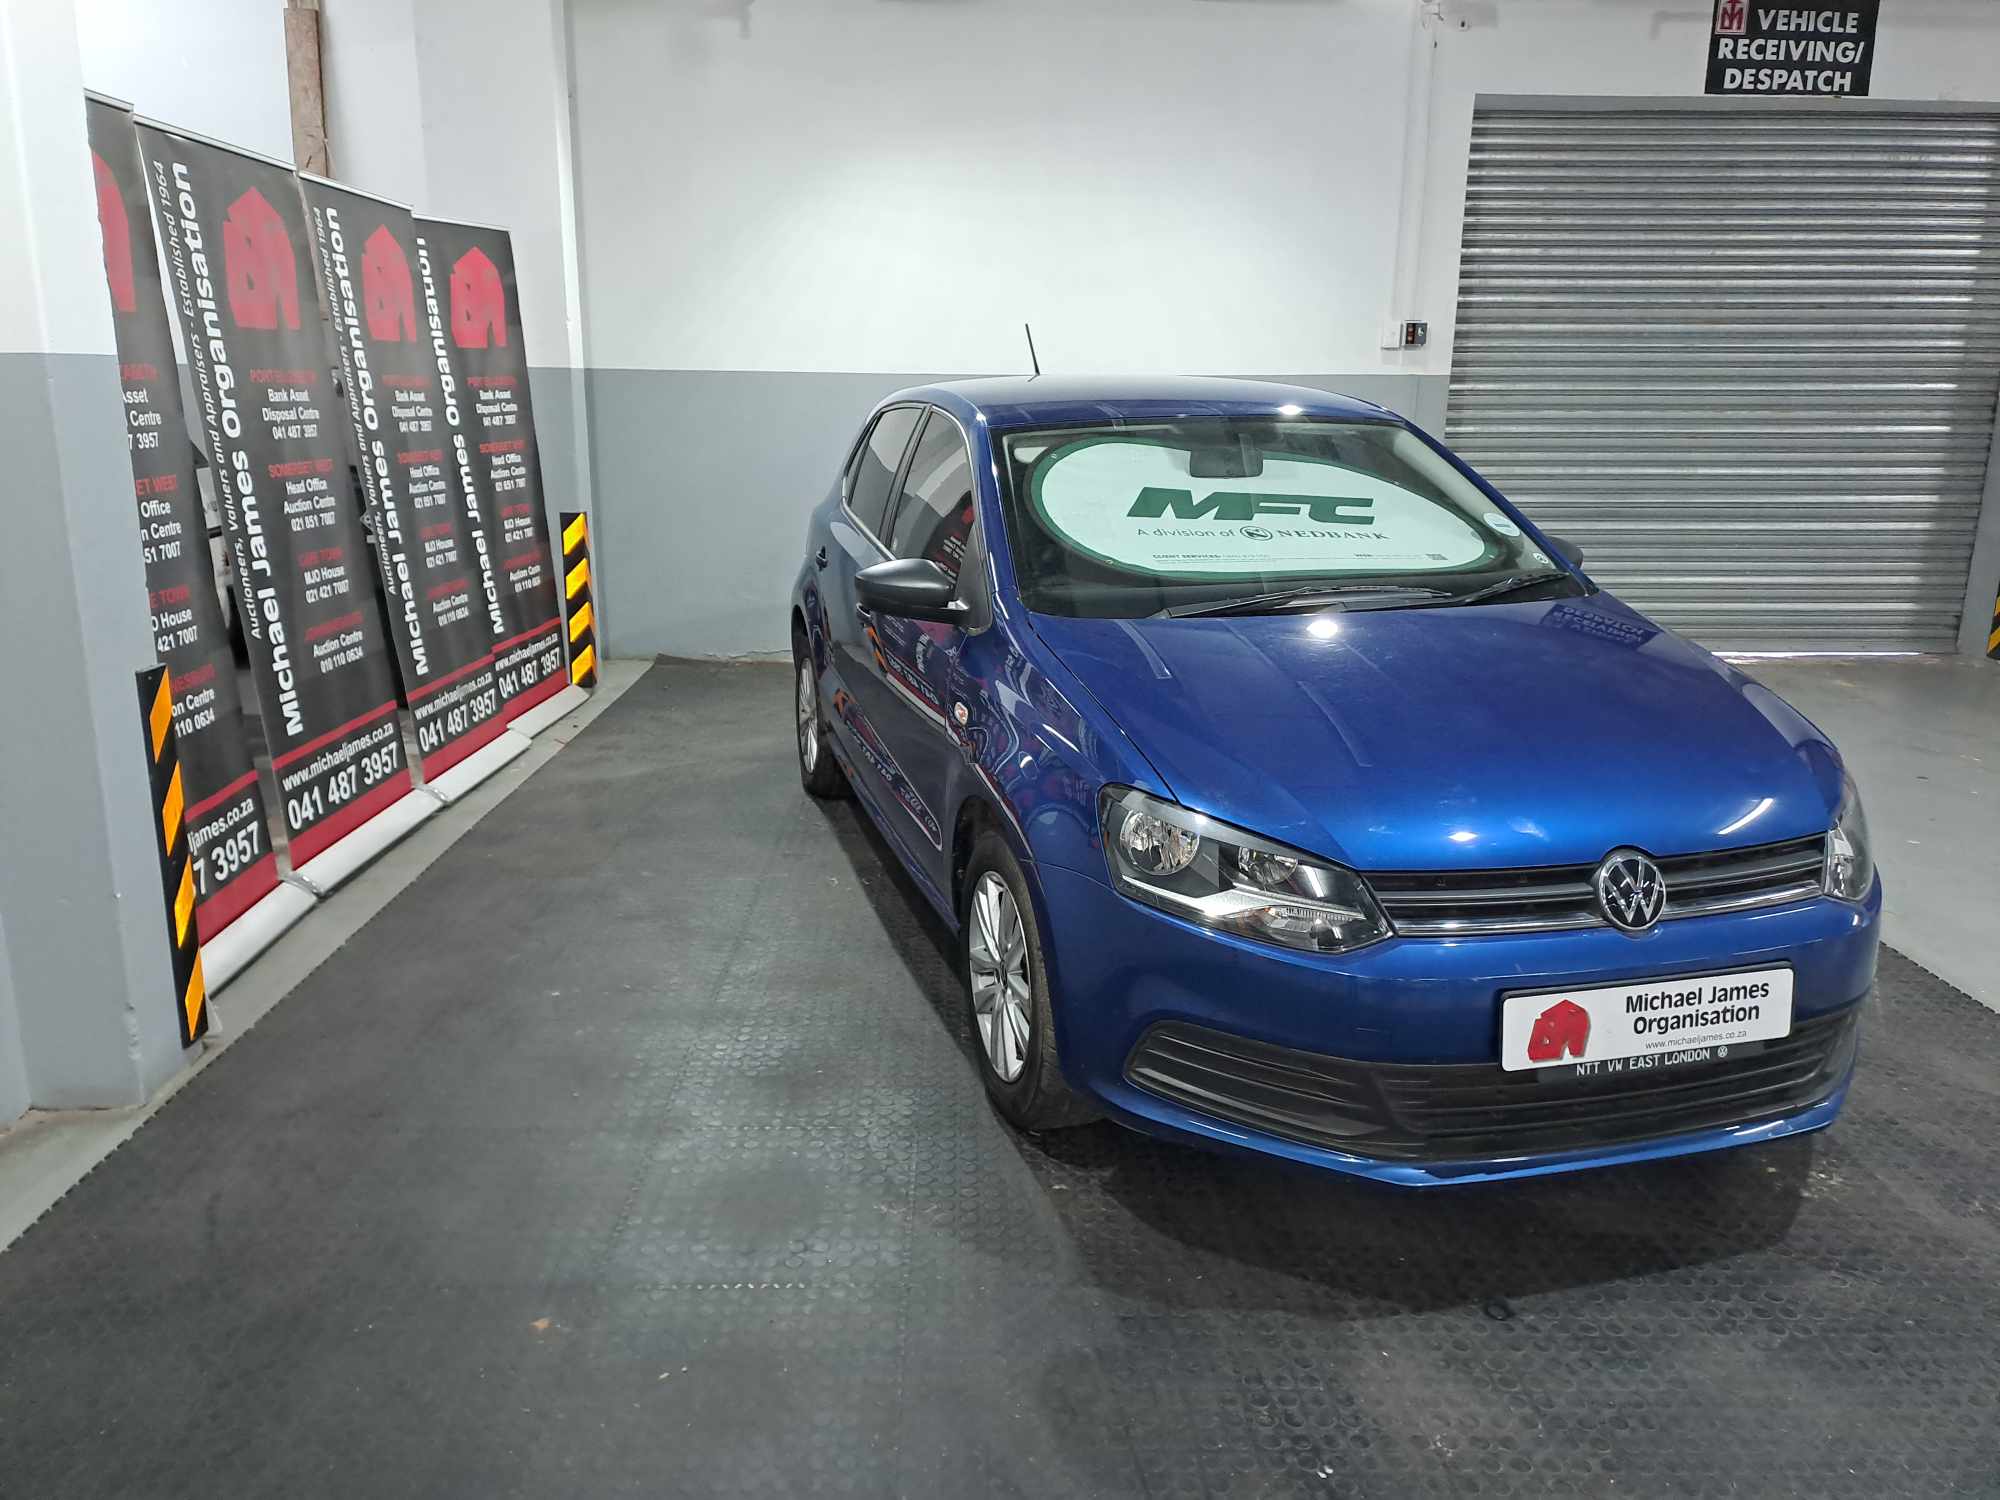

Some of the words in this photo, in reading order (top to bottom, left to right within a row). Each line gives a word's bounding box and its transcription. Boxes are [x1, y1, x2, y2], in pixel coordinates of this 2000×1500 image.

[1757, 9, 1860, 34] VEHICLE
[1717, 38, 1865, 64] RECEIVING/
[1723, 68, 1852, 92] DESPATCH
[153, 160, 172, 206] 1964
[163, 211, 195, 317] Established
[172, 162, 241, 439] Organisation
[326, 207, 378, 431] Organisation
[191, 332, 217, 426] Appraisers
[340, 345, 361, 419] Appraisers
[129, 410, 162, 426] Centre
[262, 407, 297, 424] Disposal
[136, 432, 159, 449] 3957
[208, 429, 225, 464] and
[353, 422, 367, 451] and
[362, 454, 378, 506] Valuers
[371, 440, 402, 544] James
[453, 433, 480, 523] James
[140, 500, 171, 518] Office
[219, 468, 238, 531] Valuers
[232, 450, 272, 576] James
[284, 499, 313, 515] Auction
[1126, 487, 1375, 525] MFC
[150, 521, 182, 539] Centre
[1137, 528, 1150, 536] A
[1153, 528, 1216, 537] division
[1218, 528, 1236, 537] of
[1276, 529, 1392, 540] NEDBANK
[159, 541, 181, 560] 7007
[234, 537, 261, 639] Auctioneers,
[471, 530, 504, 634] Michael
[160, 608, 192, 629] House
[392, 553, 429, 676] Michael
[157, 632, 175, 652] 421
[177, 625, 198, 646] 7007
[313, 639, 340, 658] Auction
[257, 587, 304, 736] Michael
[499, 670, 519, 699] 041
[520, 660, 538, 687] 487
[541, 647, 560, 676] 3957
[186, 688, 215, 710] Centre
[175, 718, 193, 738] 110
[194, 707, 216, 730] 0634
[419, 718, 445, 752] 041
[447, 705, 468, 736] 487
[470, 688, 497, 722] 3957
[282, 722, 394, 792] www.michaeljames.co.za
[287, 785, 324, 830] 041
[328, 764, 357, 804] 487
[361, 741, 398, 785] 3957
[211, 821, 259, 881] 3957
[1625, 987, 1703, 1013] Michael
[1708, 982, 1770, 1004] James
[1633, 1004, 1760, 1036] Organisation
[1645, 1029, 1747, 1049] www.michaeljames.co.za
[1576, 1062, 1601, 1076] NTT
[1607, 1058, 1624, 1073] VW
[1629, 1054, 1660, 1069] EAST
[1664, 1047, 1711, 1066] LONDON
